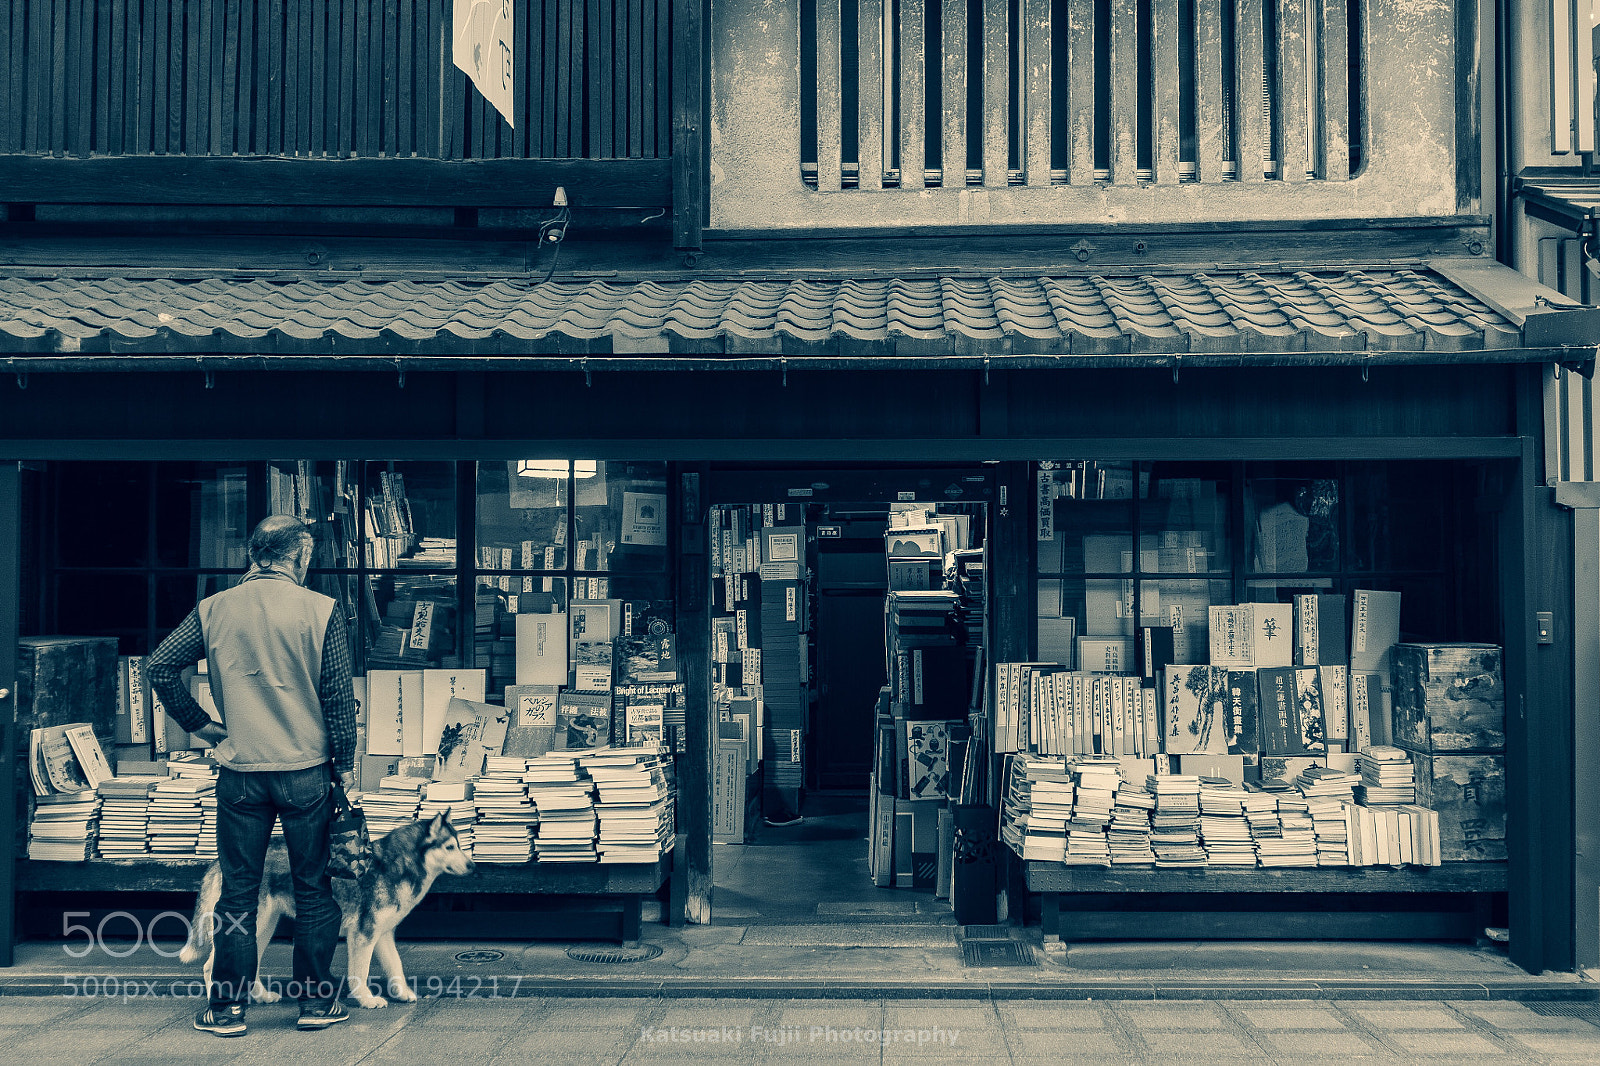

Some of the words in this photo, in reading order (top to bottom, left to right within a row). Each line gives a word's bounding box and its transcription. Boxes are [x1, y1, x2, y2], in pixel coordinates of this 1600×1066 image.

[1039, 472, 1052, 539] 古書高価買取
[1261, 617, 1282, 641] 筆
[616, 686, 636, 696] Bright
[637, 685, 645, 695] of
[645, 685, 671, 696] Lacquer
[671, 684, 683, 693] Art
